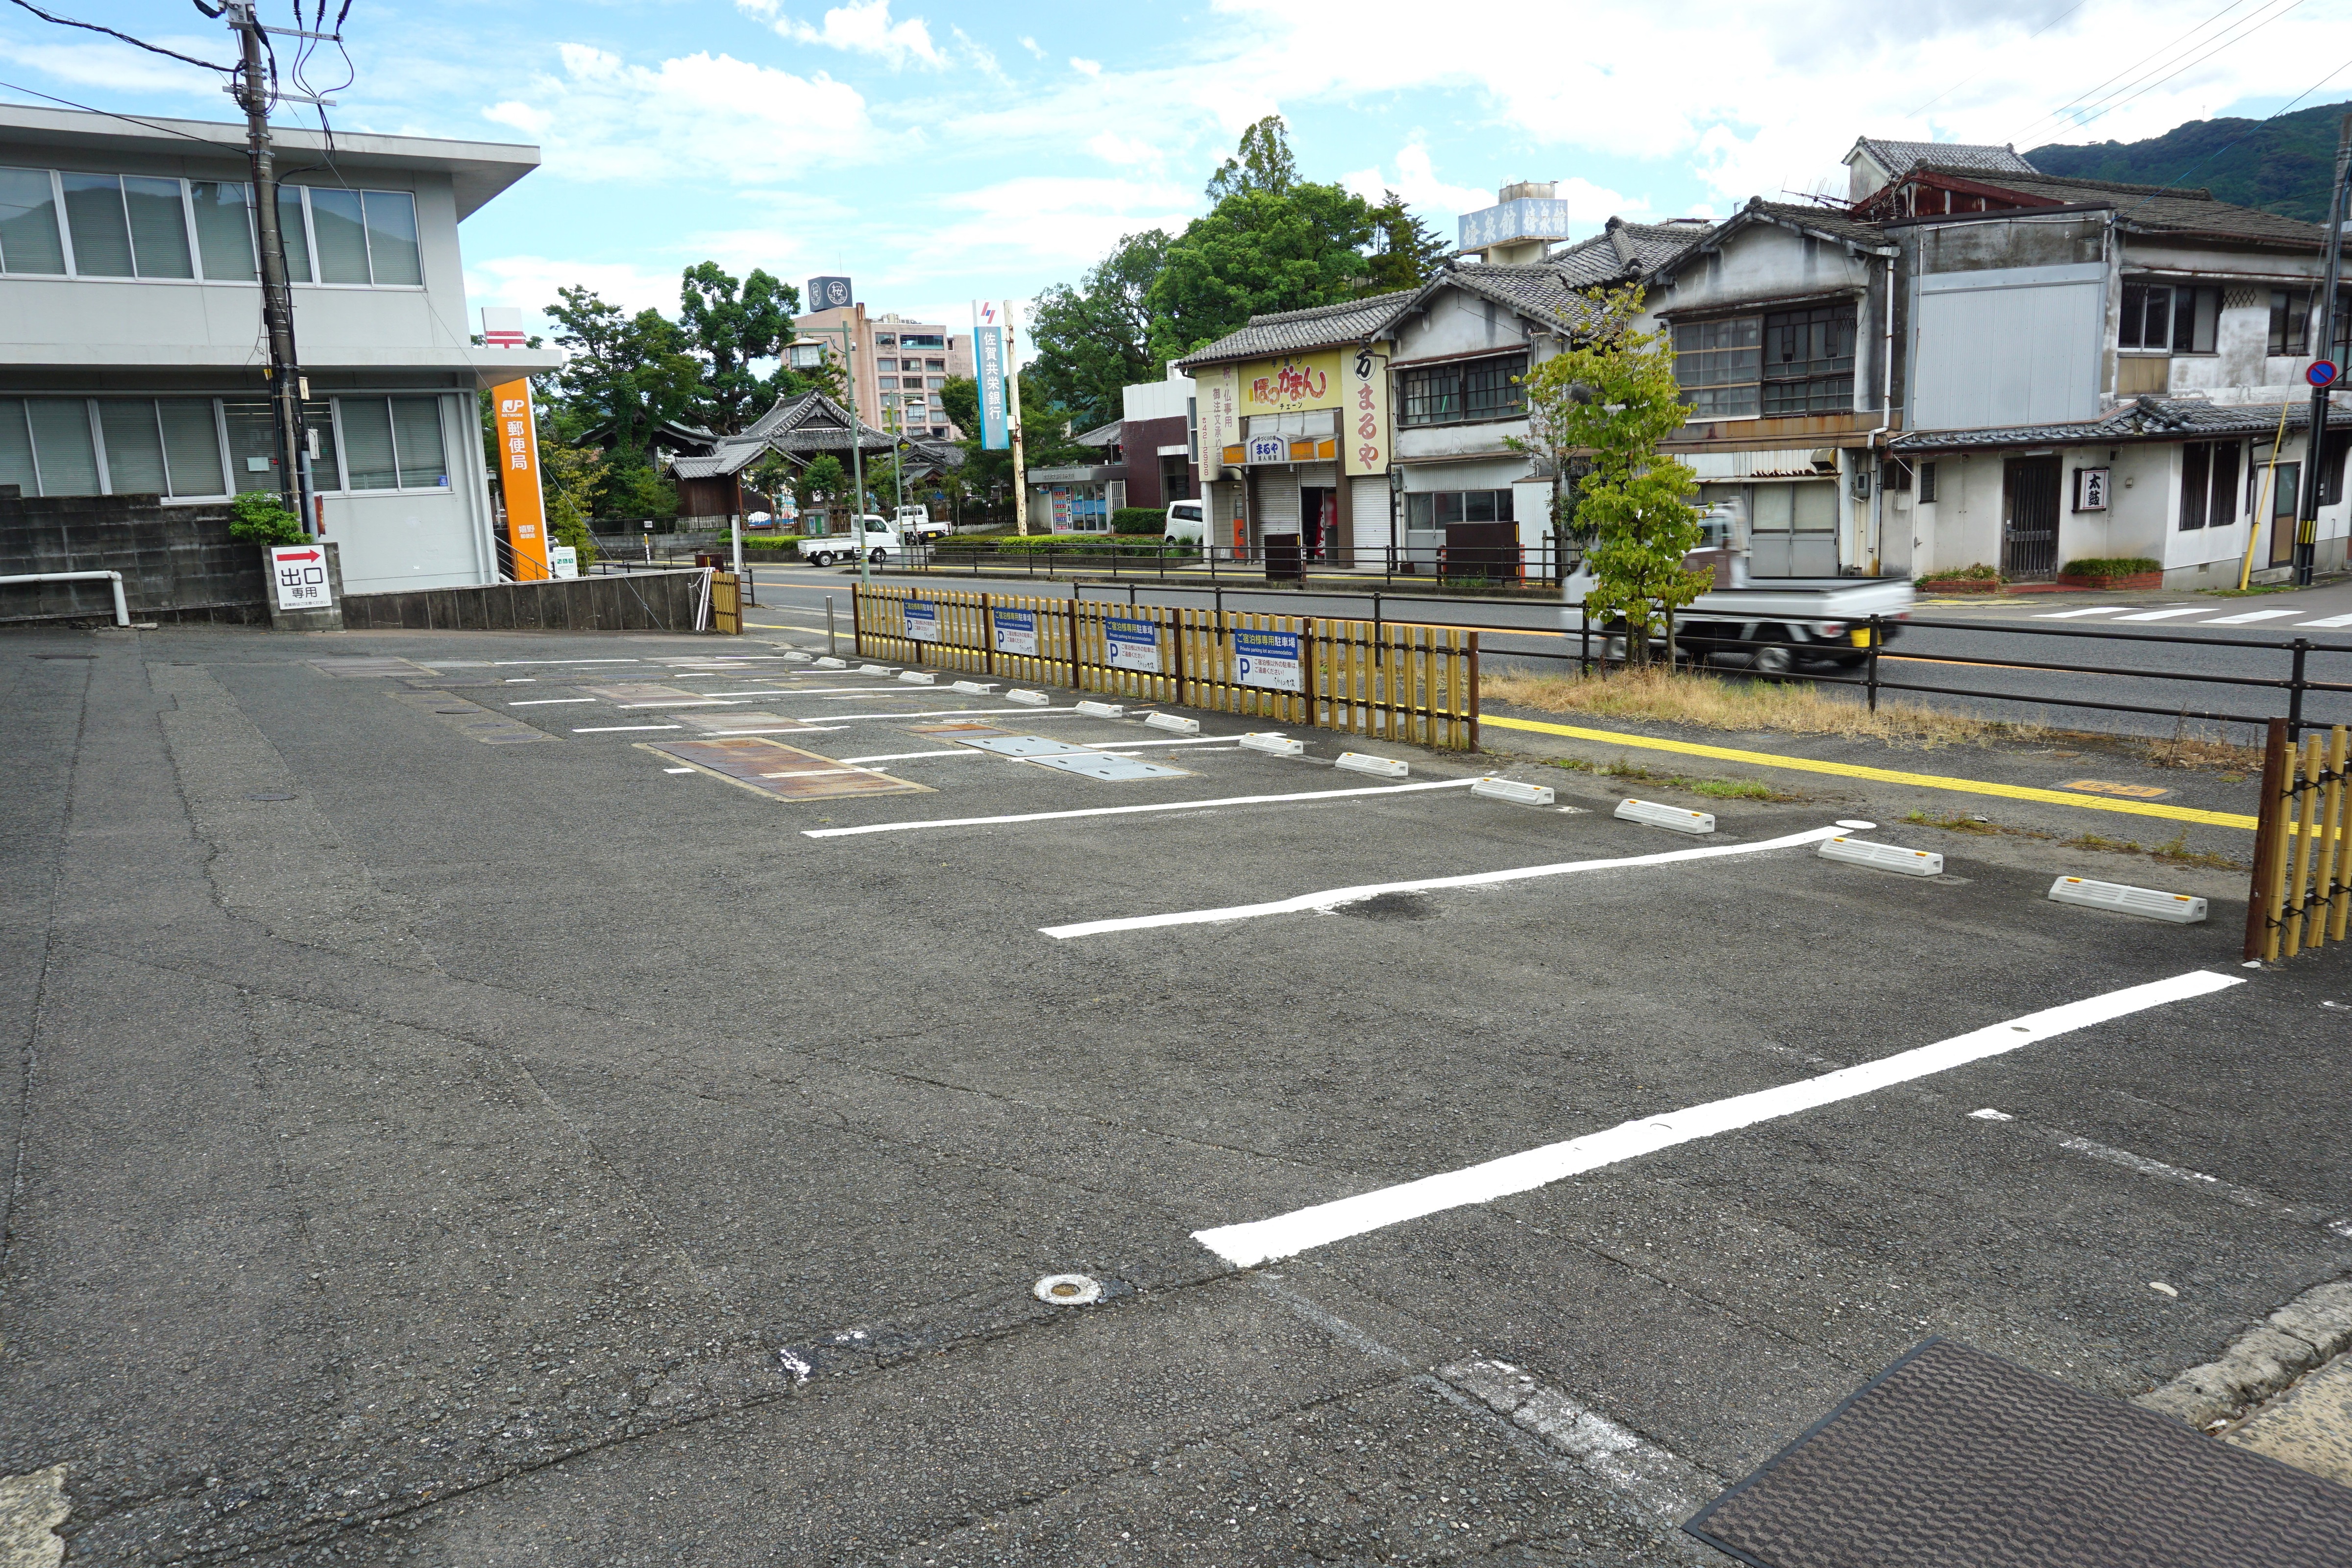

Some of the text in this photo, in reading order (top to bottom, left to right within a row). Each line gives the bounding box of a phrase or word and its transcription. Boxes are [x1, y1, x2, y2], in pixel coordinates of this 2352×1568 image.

[832, 284, 843, 296] 桜
[1272, 356, 1301, 368] 手造り
[983, 332, 1001, 420] 佐賀共栄銀行
[1280, 402, 1302, 410] チェーン
[1357, 383, 1379, 470] まるや
[507, 421, 527, 470] 郵便局
[1256, 442, 1278, 455] まるや
[281, 567, 323, 587] 出口
[291, 587, 318, 598] 専用
[907, 619, 912, 636] P
[1107, 621, 1153, 635] ご宿泊様専用駐車場
[997, 630, 1004, 648] P
[1237, 633, 1295, 648] ご宿泊様専用駐車場
[1109, 643, 1118, 663] P
[1240, 658, 1250, 681] P
